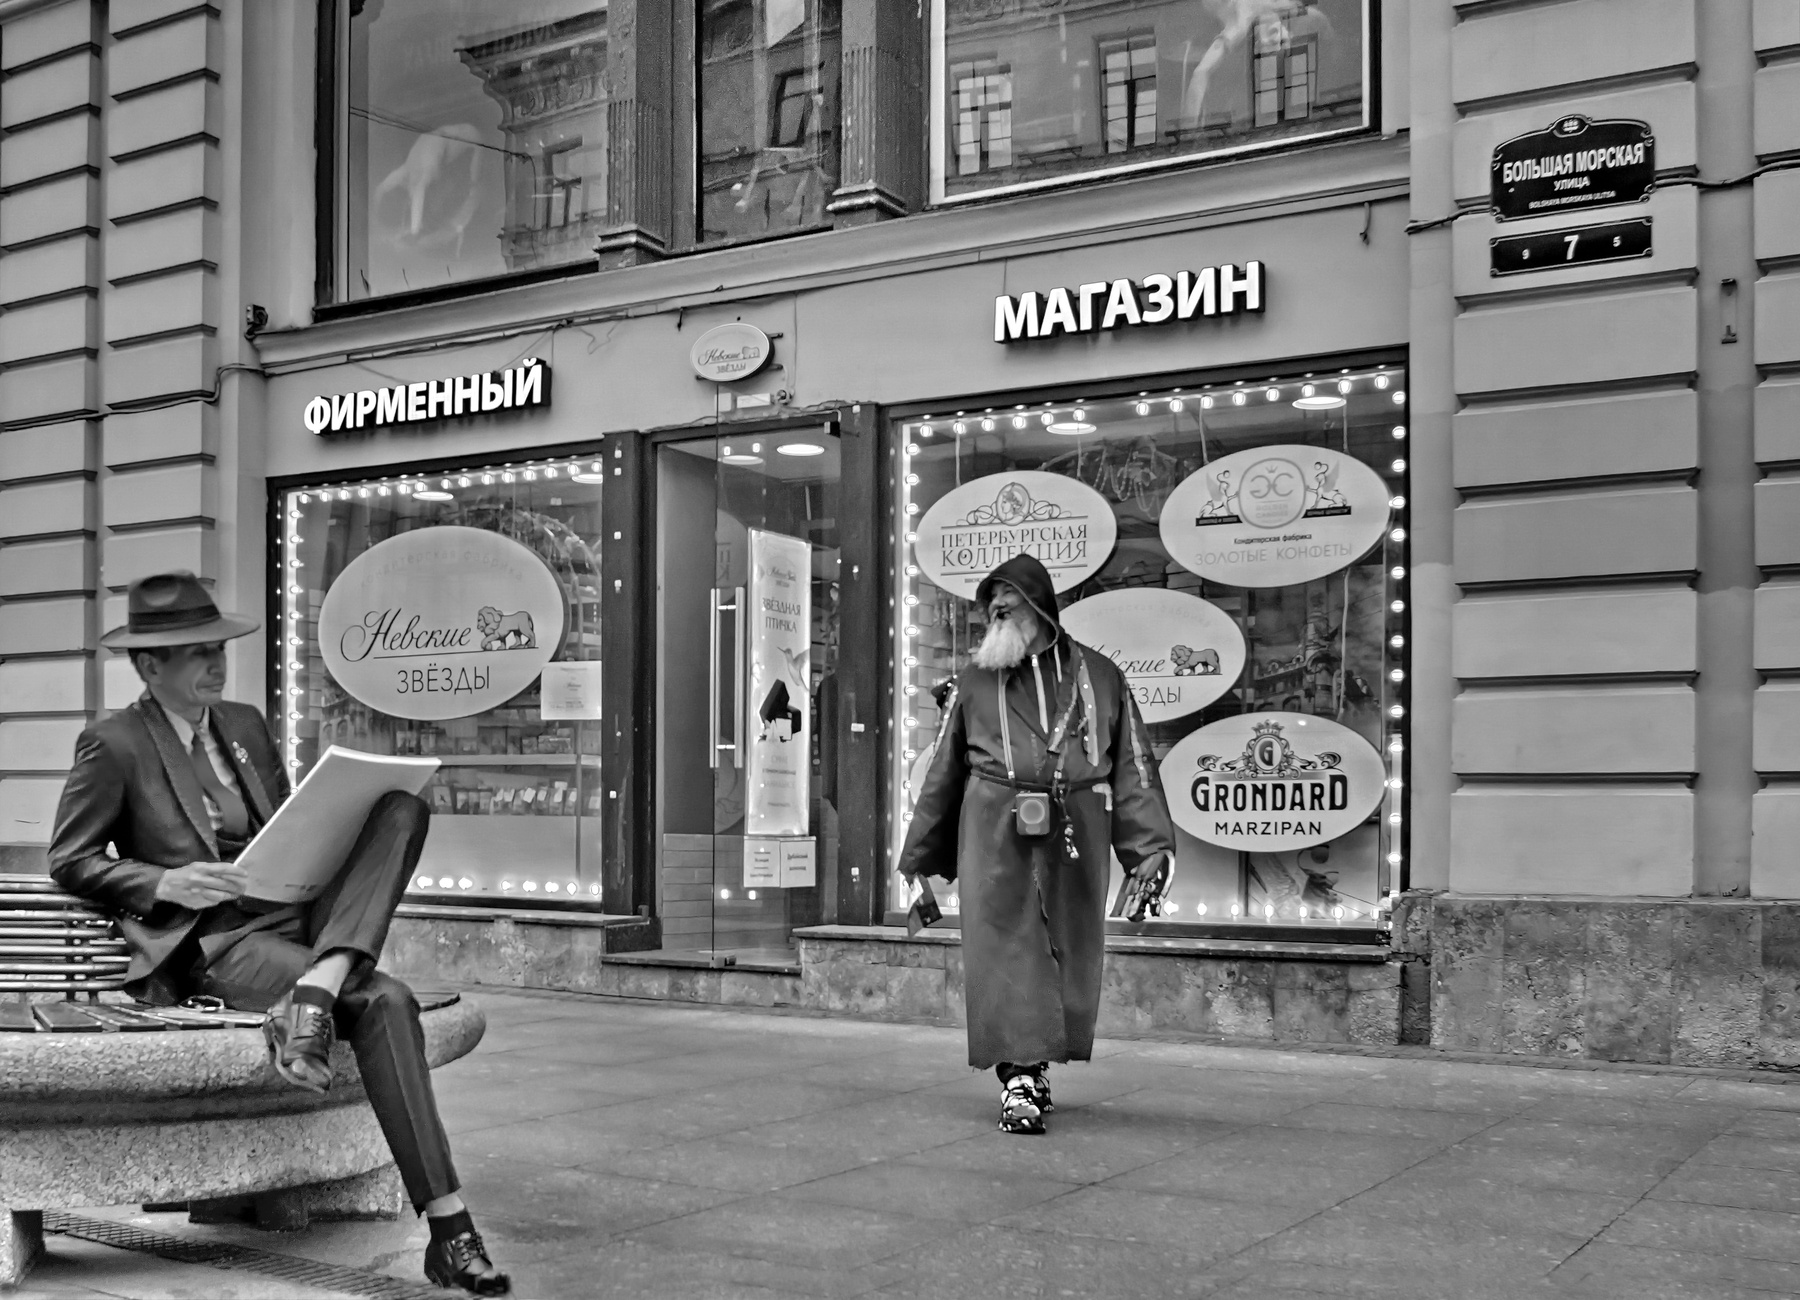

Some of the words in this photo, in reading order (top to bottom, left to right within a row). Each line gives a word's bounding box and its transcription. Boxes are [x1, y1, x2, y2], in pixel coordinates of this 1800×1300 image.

[1503, 153, 1573, 183] БОЛЬШАЯ
[1576, 143, 1644, 172] МОРСКАЯ
[1554, 176, 1591, 191] УЛИЦА
[1564, 235, 1579, 260] 7
[1613, 236, 1621, 247] 5
[1522, 249, 1530, 260] 9
[994, 260, 1262, 342] МАГАЗИН
[304, 357, 543, 434] ФИРМЕННЫЙ
[941, 524, 1087, 548] ПЕТЕРБУРГСКАЯ
[1195, 549, 1267, 566] ЗОЛОТЫЕ
[1277, 543, 1352, 560] КОНФЕТЫ
[340, 608, 472, 662] Невские
[765, 616, 797, 633] ПТИЧКА
[396, 663, 490, 695] ЗВЁЗДЫ
[1258, 740, 1274, 766] G
[1191, 774, 1348, 812] GRONDARD
[1214, 821, 1322, 836] MARZIPAN
